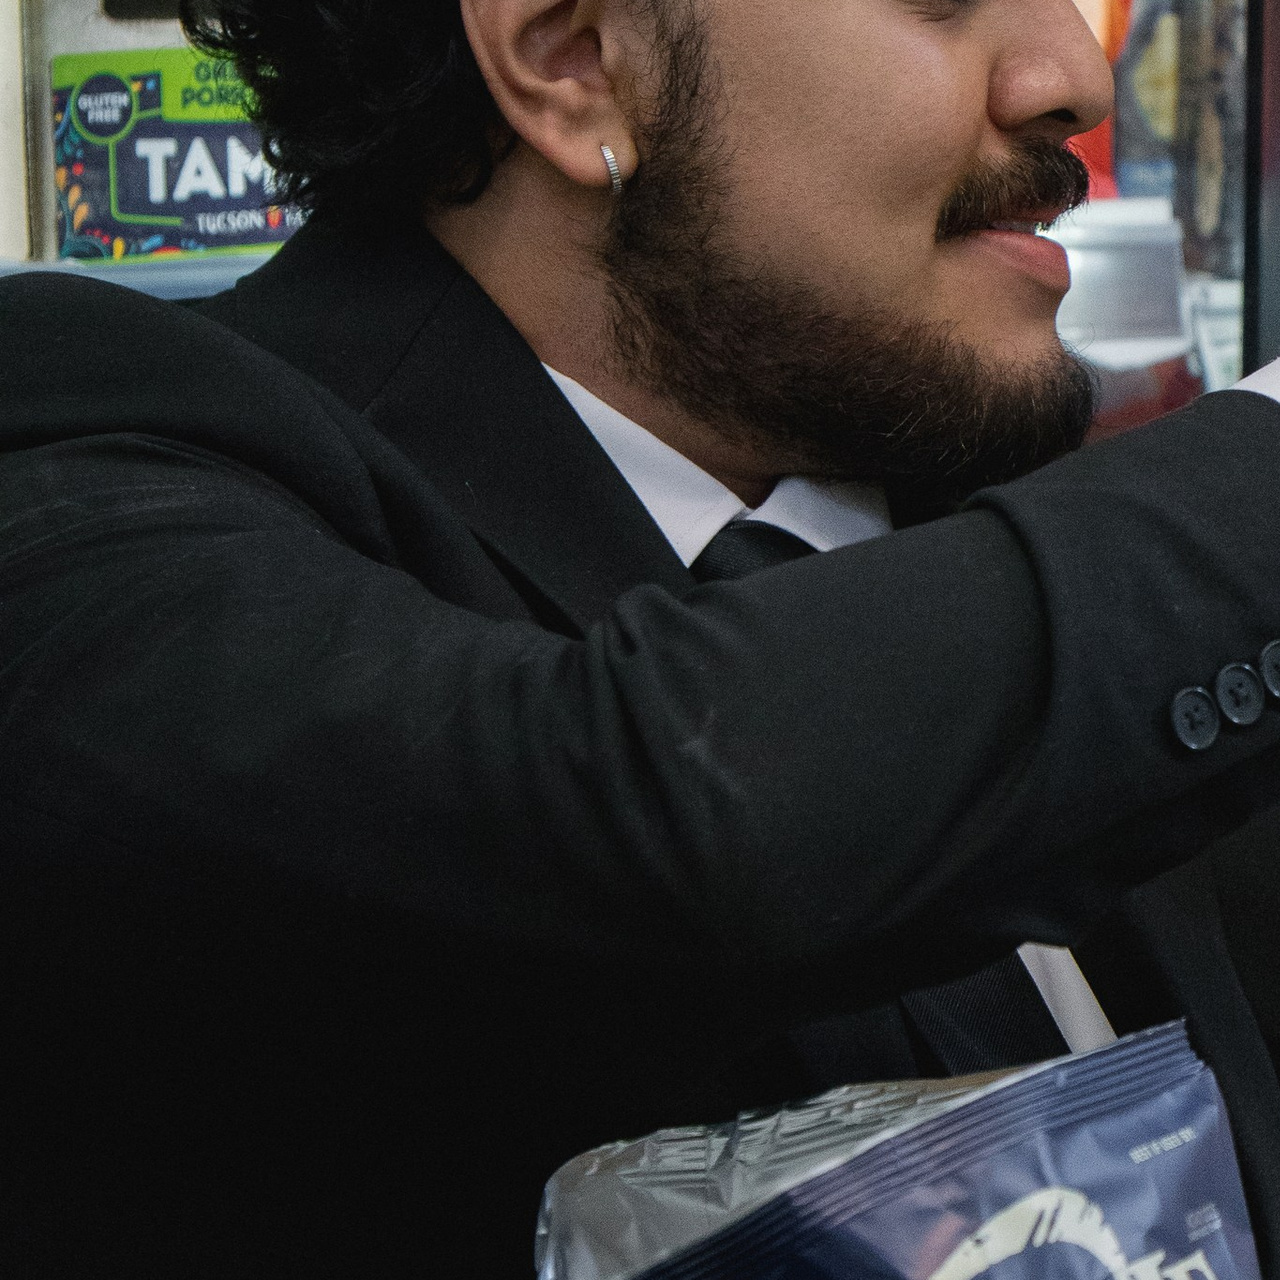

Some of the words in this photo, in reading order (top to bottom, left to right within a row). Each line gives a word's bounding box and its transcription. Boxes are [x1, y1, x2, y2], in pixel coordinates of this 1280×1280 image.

[77, 91, 130, 109] GLUTEN
[87, 107, 121, 124] FREE
[135, 134, 277, 205] TAM
[196, 209, 265, 235] TUCSON
